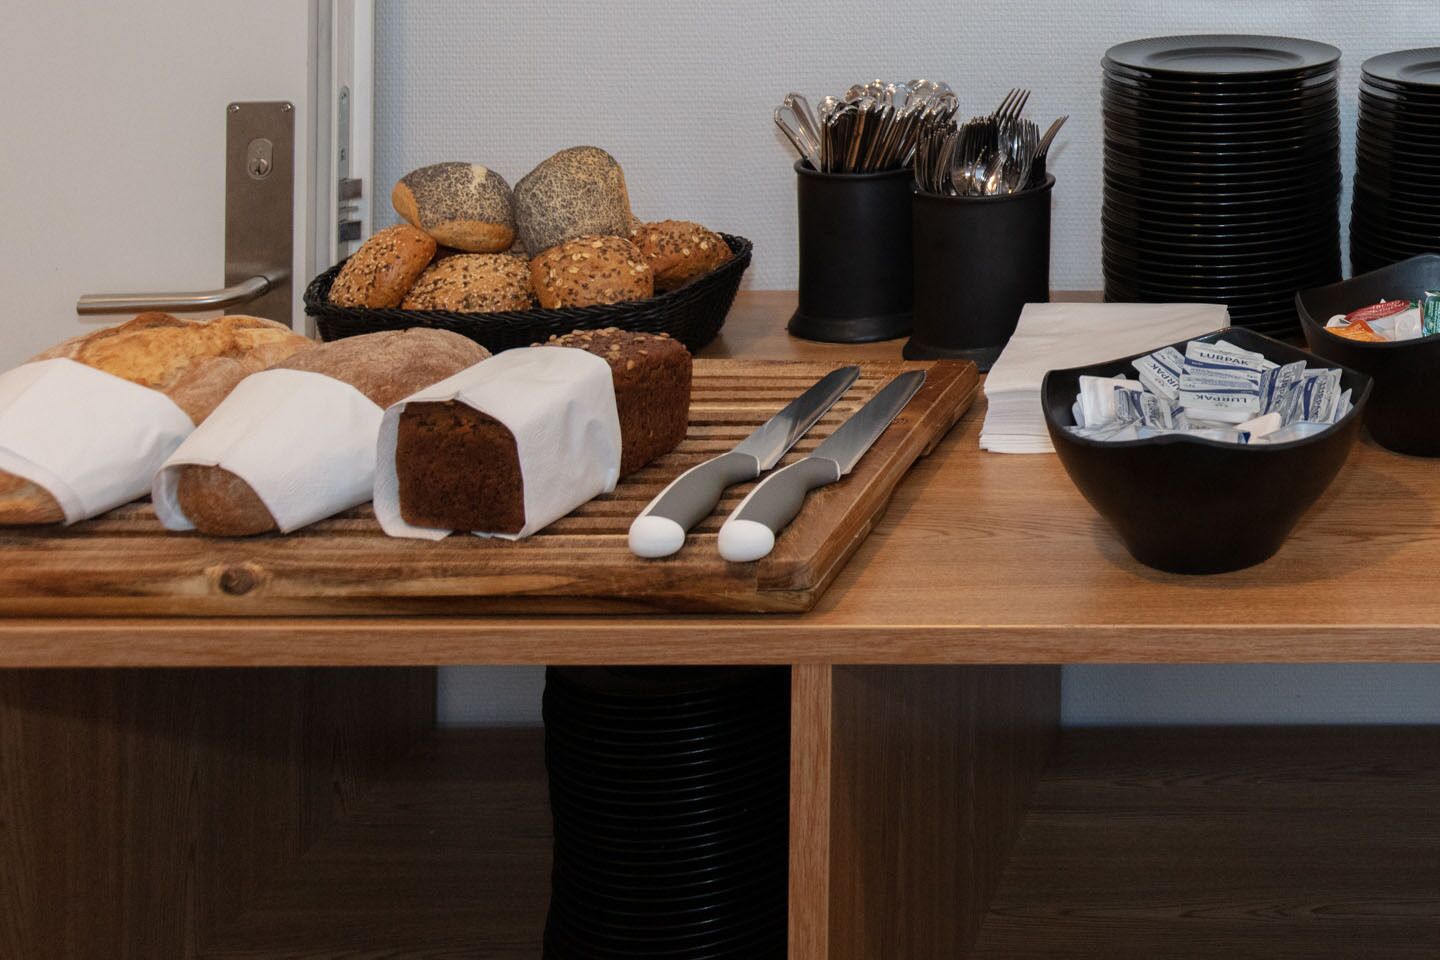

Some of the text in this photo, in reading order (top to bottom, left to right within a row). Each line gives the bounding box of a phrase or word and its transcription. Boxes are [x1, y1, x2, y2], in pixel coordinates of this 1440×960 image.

[1200, 352, 1249, 366] LURPAK
[1150, 363, 1180, 391] URPAK
[1195, 393, 1248, 404] LURPAK
